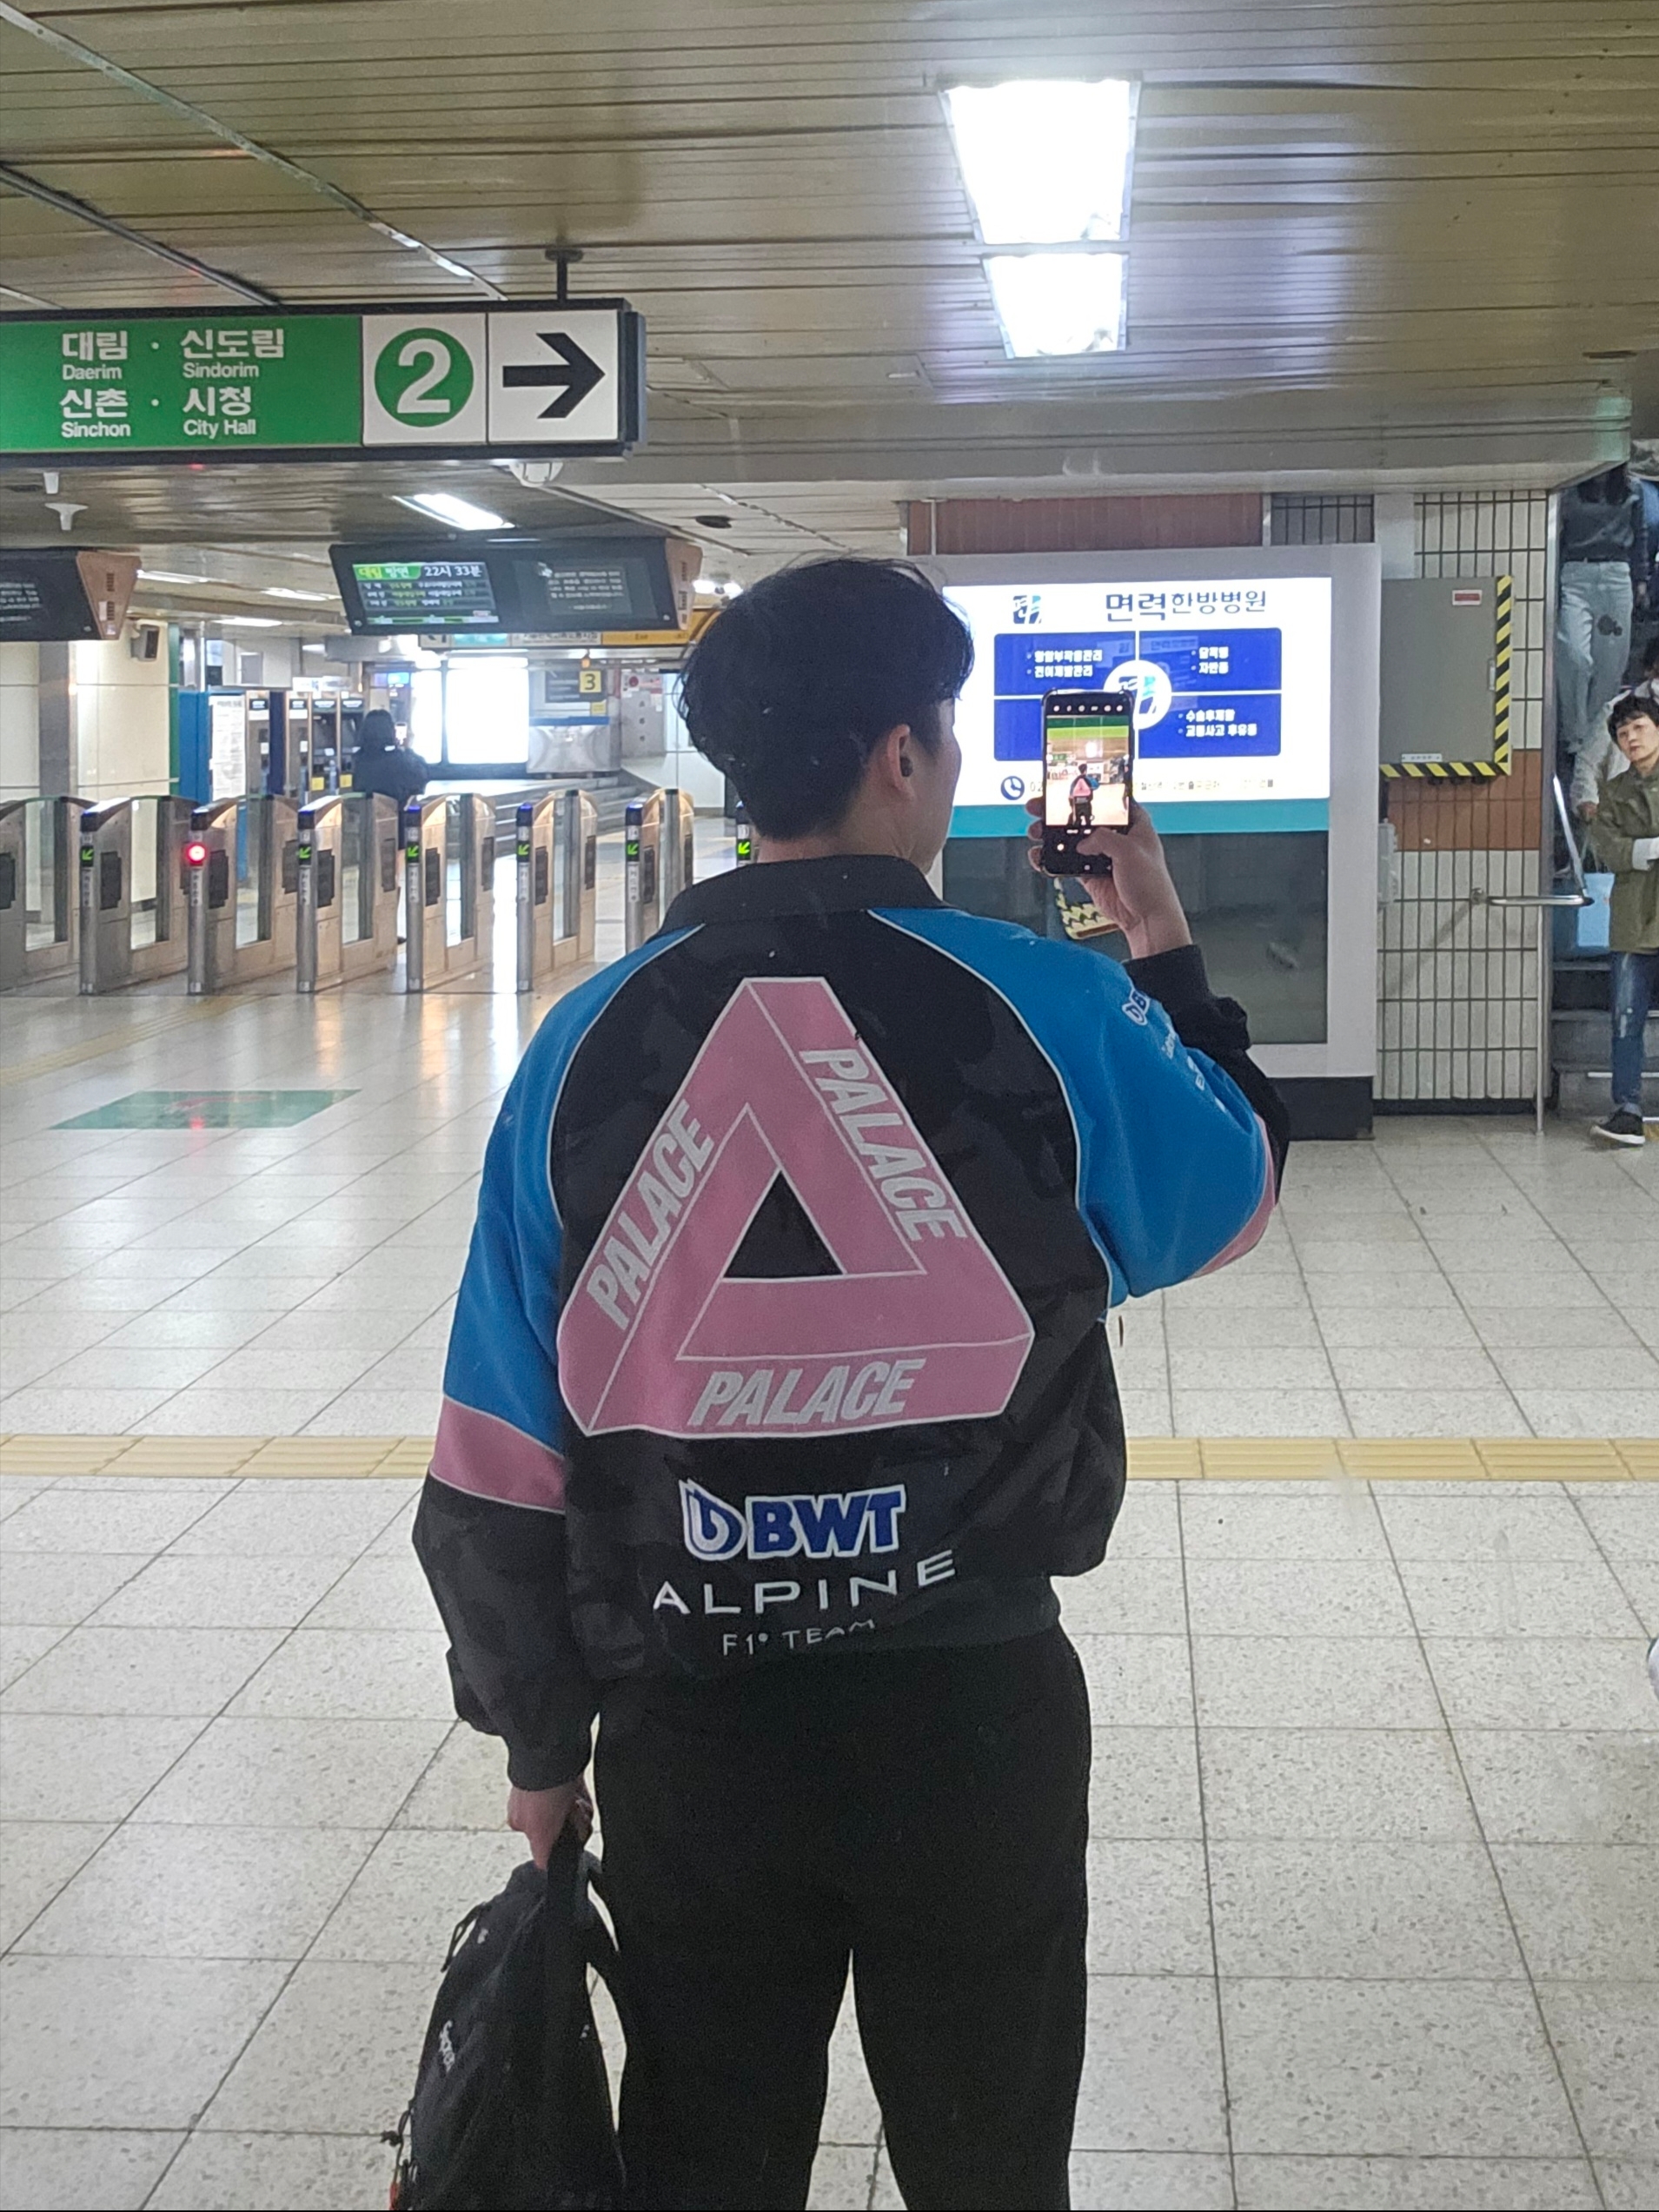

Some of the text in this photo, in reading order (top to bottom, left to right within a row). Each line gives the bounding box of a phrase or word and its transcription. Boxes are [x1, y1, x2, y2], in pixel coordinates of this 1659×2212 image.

[62, 328, 284, 361] 대림 신도림
[62, 361, 260, 381] Daerim Sindorim
[59, 386, 252, 419] 신촌 시청
[61, 419, 257, 439] Sinchon City Hall
[424, 565, 452, 578] 22시
[1105, 590, 1266, 622] 면력한방병원
[583, 673, 597, 690] 3
[800, 1049, 968, 1242] PALACE
[586, 1099, 715, 1329] PALACE
[687, 1359, 926, 1426] PALACE
[745, 1484, 906, 1560] BWT
[653, 1549, 956, 1614] ALPINE
[782, 1618, 875, 1649] TEAM
